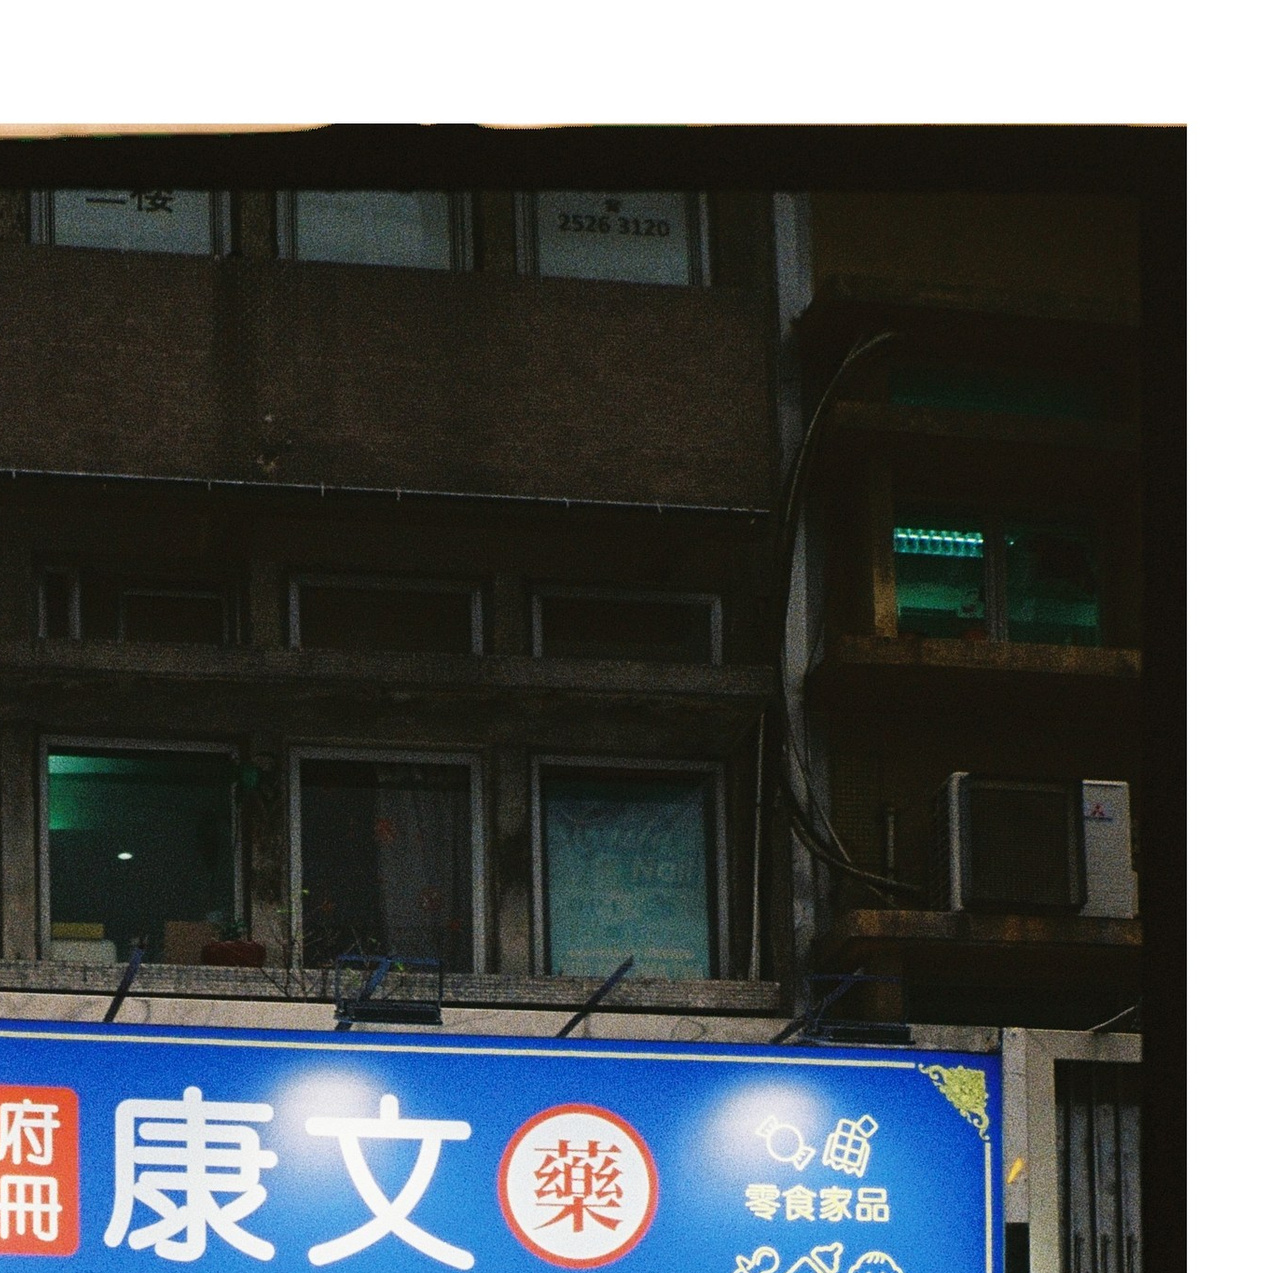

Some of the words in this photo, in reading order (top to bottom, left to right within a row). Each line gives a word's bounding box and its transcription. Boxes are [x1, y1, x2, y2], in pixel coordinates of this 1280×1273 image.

[557, 213, 612, 232] 2526
[617, 216, 671, 237] 3120
[104, 1086, 475, 1271] 康文
[532, 1138, 626, 1235] 藥
[744, 1184, 891, 1223] 零食家品
